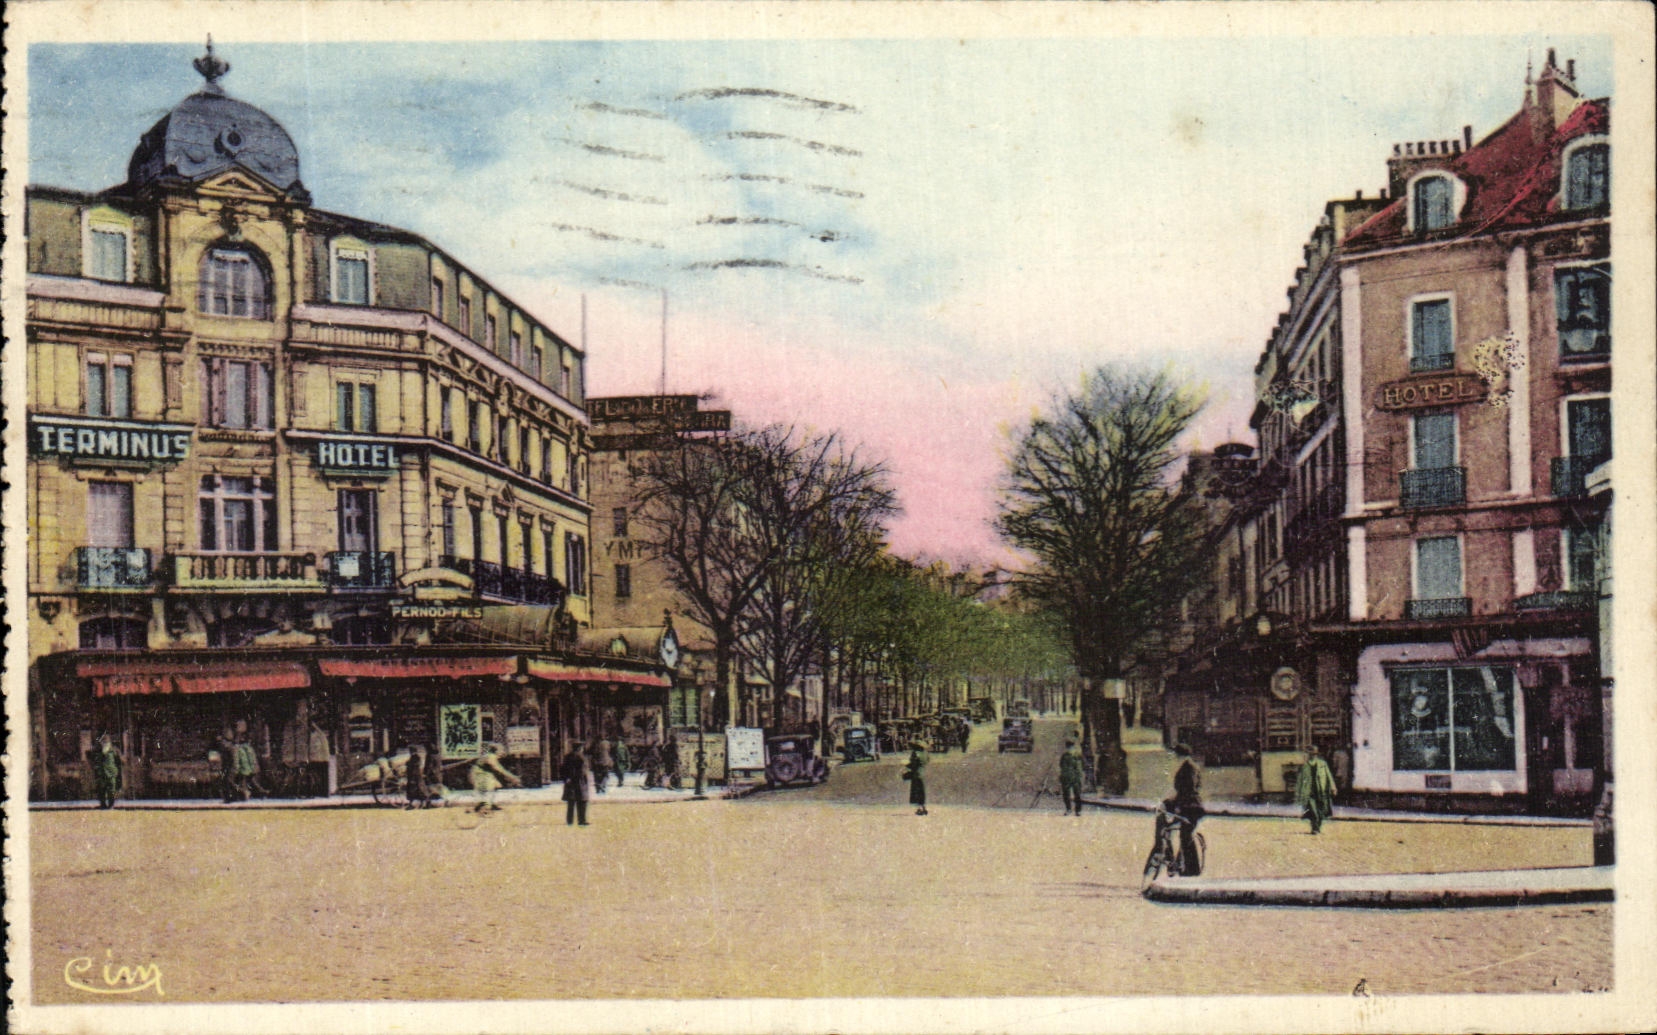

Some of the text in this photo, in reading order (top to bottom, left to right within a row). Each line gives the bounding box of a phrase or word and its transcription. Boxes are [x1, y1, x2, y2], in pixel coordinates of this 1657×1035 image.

[1384, 380, 1474, 405] HOTEL
[37, 426, 191, 459] TERMINUS
[318, 442, 400, 468] HOTEL
